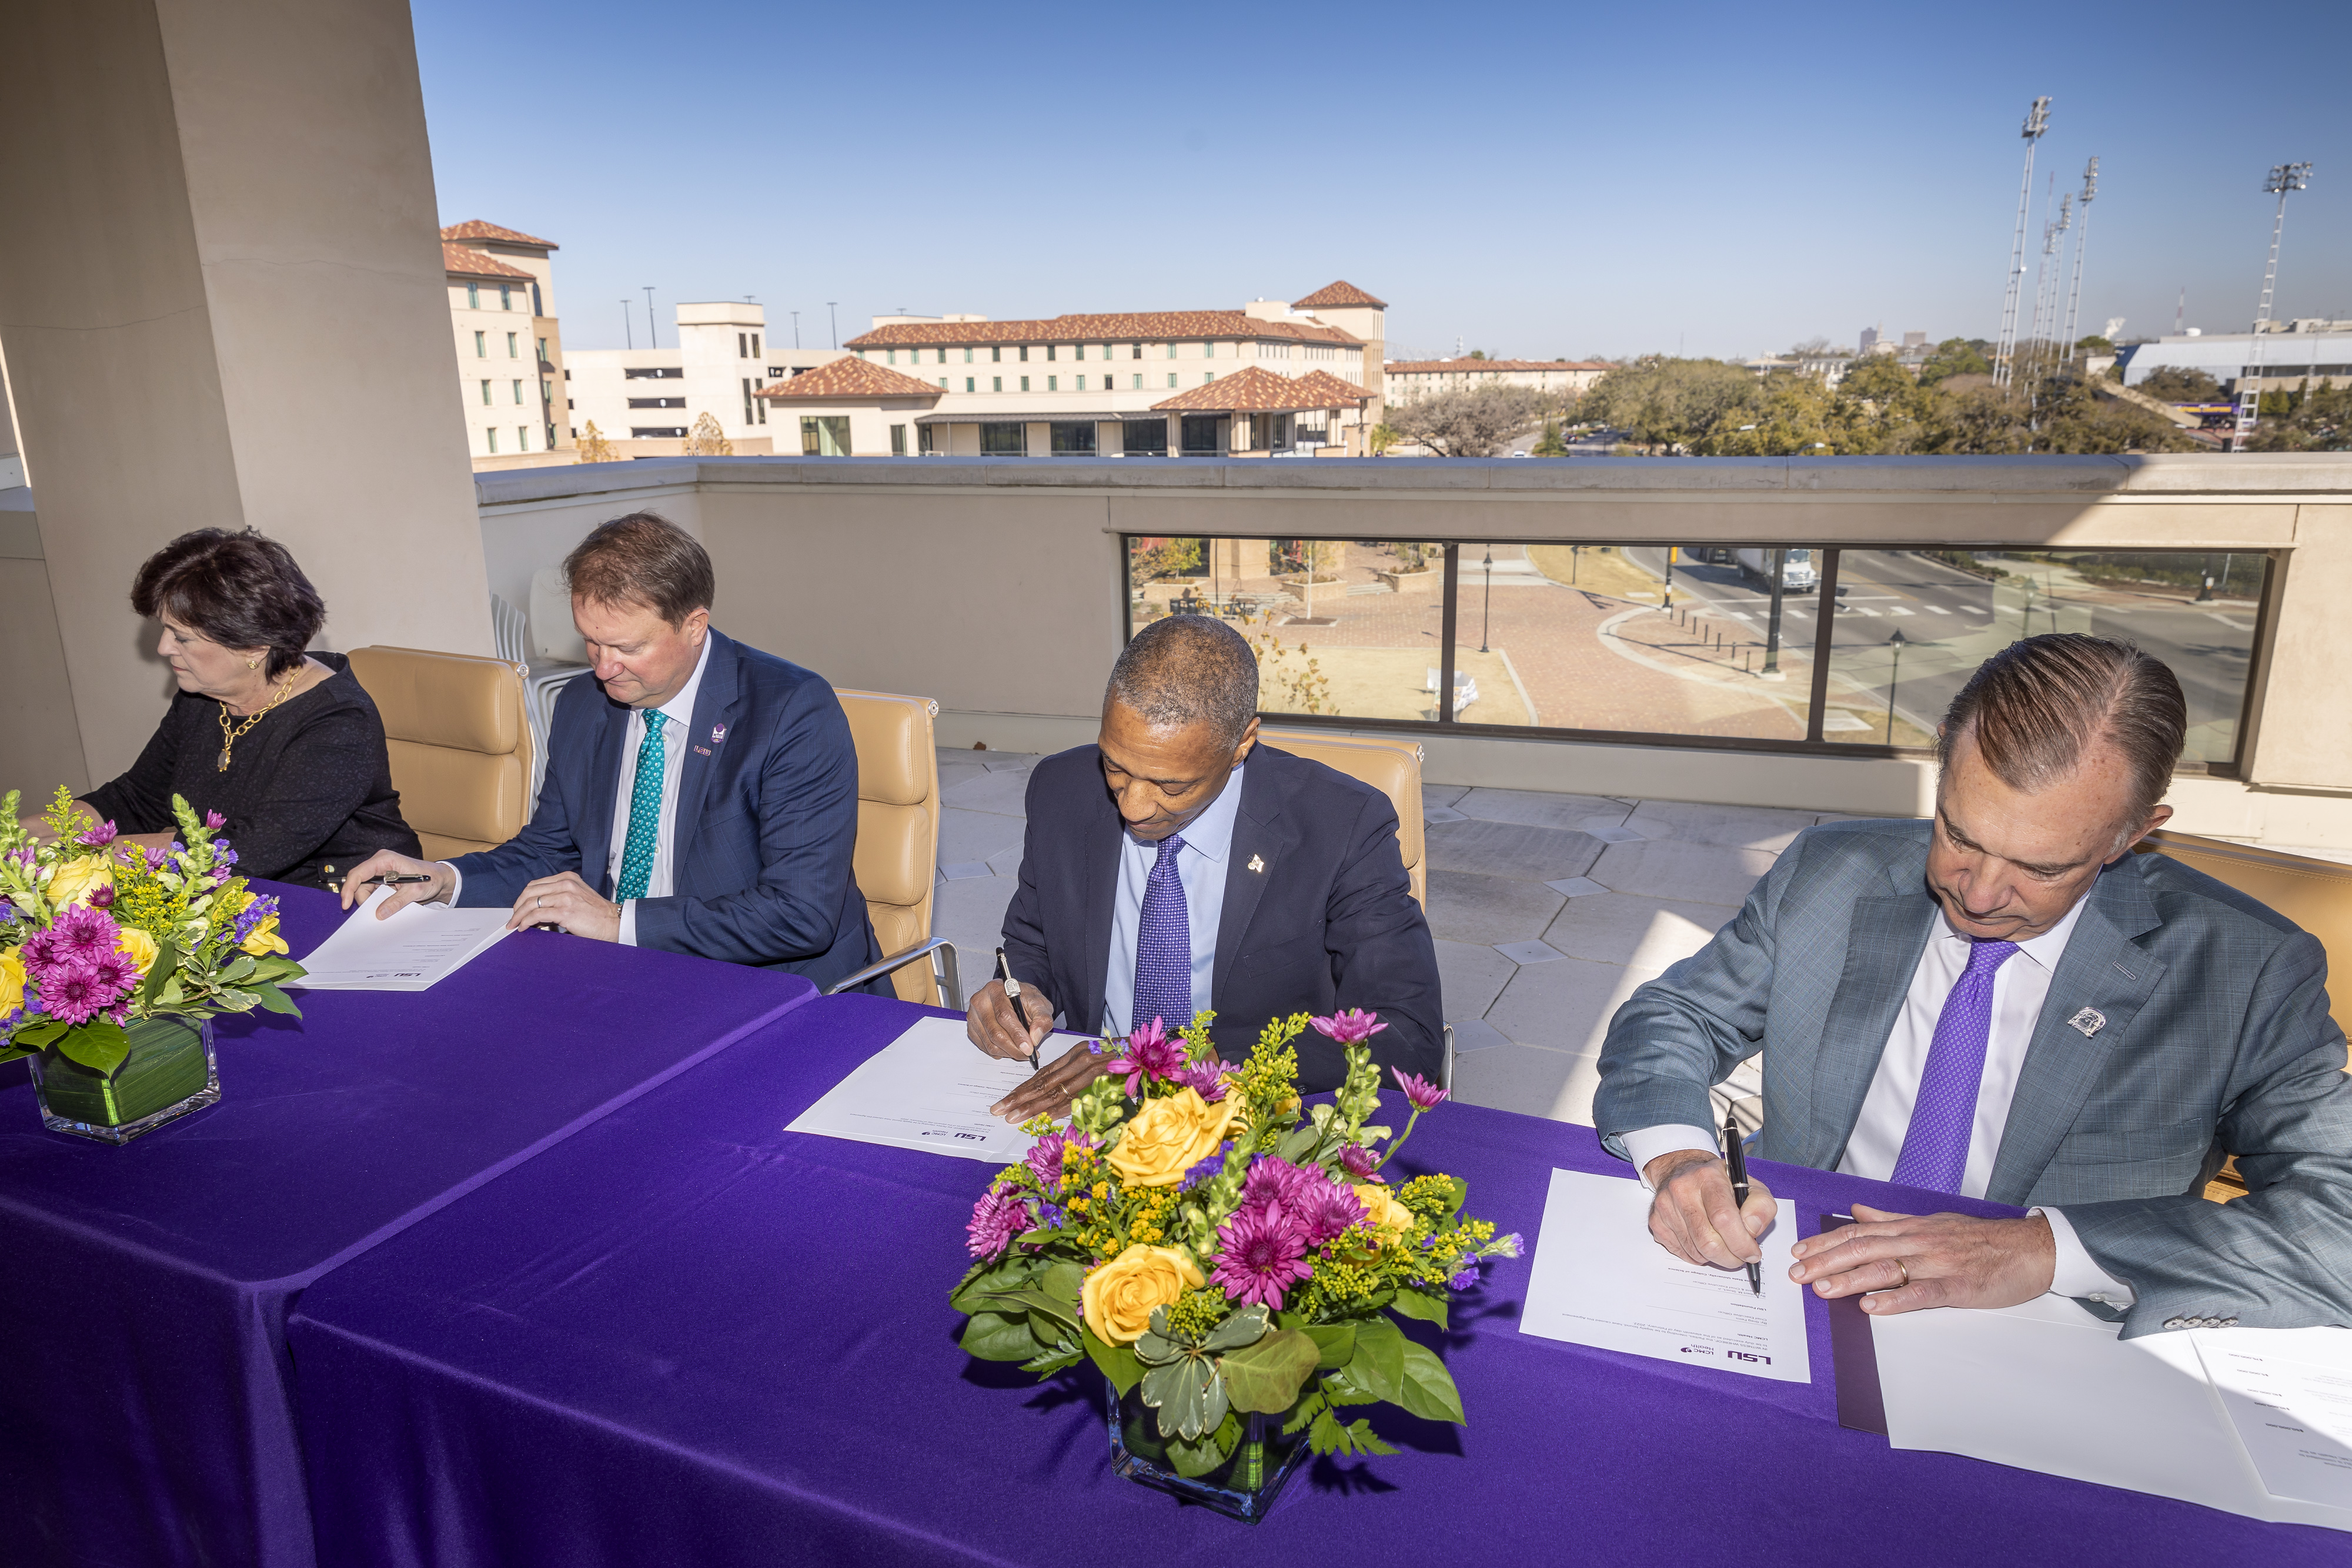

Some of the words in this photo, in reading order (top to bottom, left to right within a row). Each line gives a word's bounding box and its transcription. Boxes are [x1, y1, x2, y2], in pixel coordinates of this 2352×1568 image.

[694, 745, 711, 757] LSU
[954, 1132, 986, 1141] LSU
[1728, 1350, 1771, 1365] LSU
